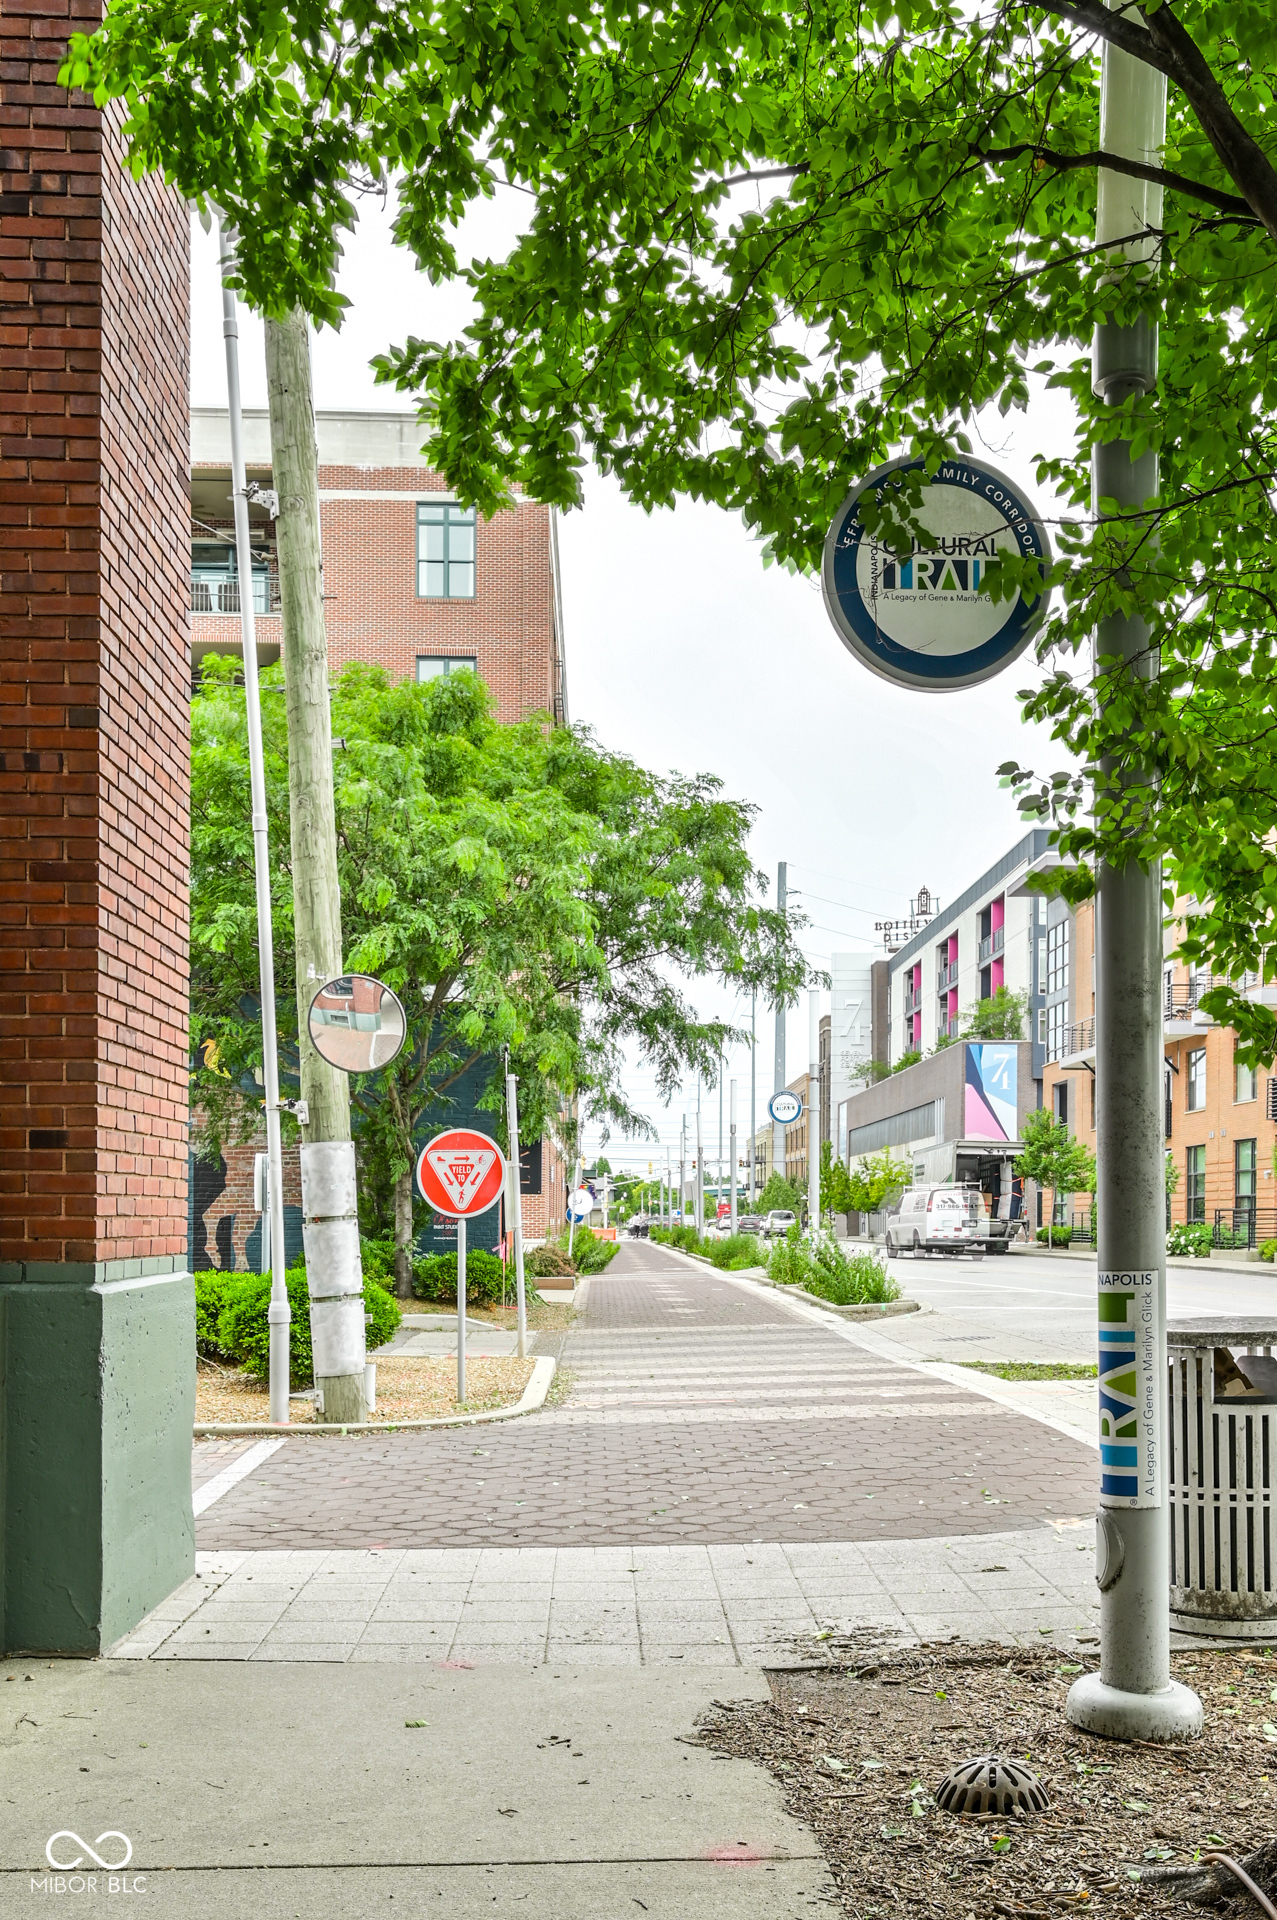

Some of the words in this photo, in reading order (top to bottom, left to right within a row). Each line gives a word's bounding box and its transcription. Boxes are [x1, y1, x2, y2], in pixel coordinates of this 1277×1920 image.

[985, 484, 1037, 557] CORRIDOR
[891, 593, 917, 603] Legacy
[919, 593, 926, 601] of
[928, 594, 948, 602] Gene
[956, 594, 983, 604] Marilyn
[884, 931, 919, 943] DIS
[452, 1165, 471, 1174] YIELD
[457, 1174, 465, 1183] TO
[1141, 1291, 1153, 1322] Glick
[1141, 1326, 1155, 1371] Marilyn
[1143, 1385, 1154, 1419] Gene
[1143, 1423, 1154, 1435] of
[1144, 1439, 1156, 1483] Legacy
[1145, 1486, 1154, 1496] A
